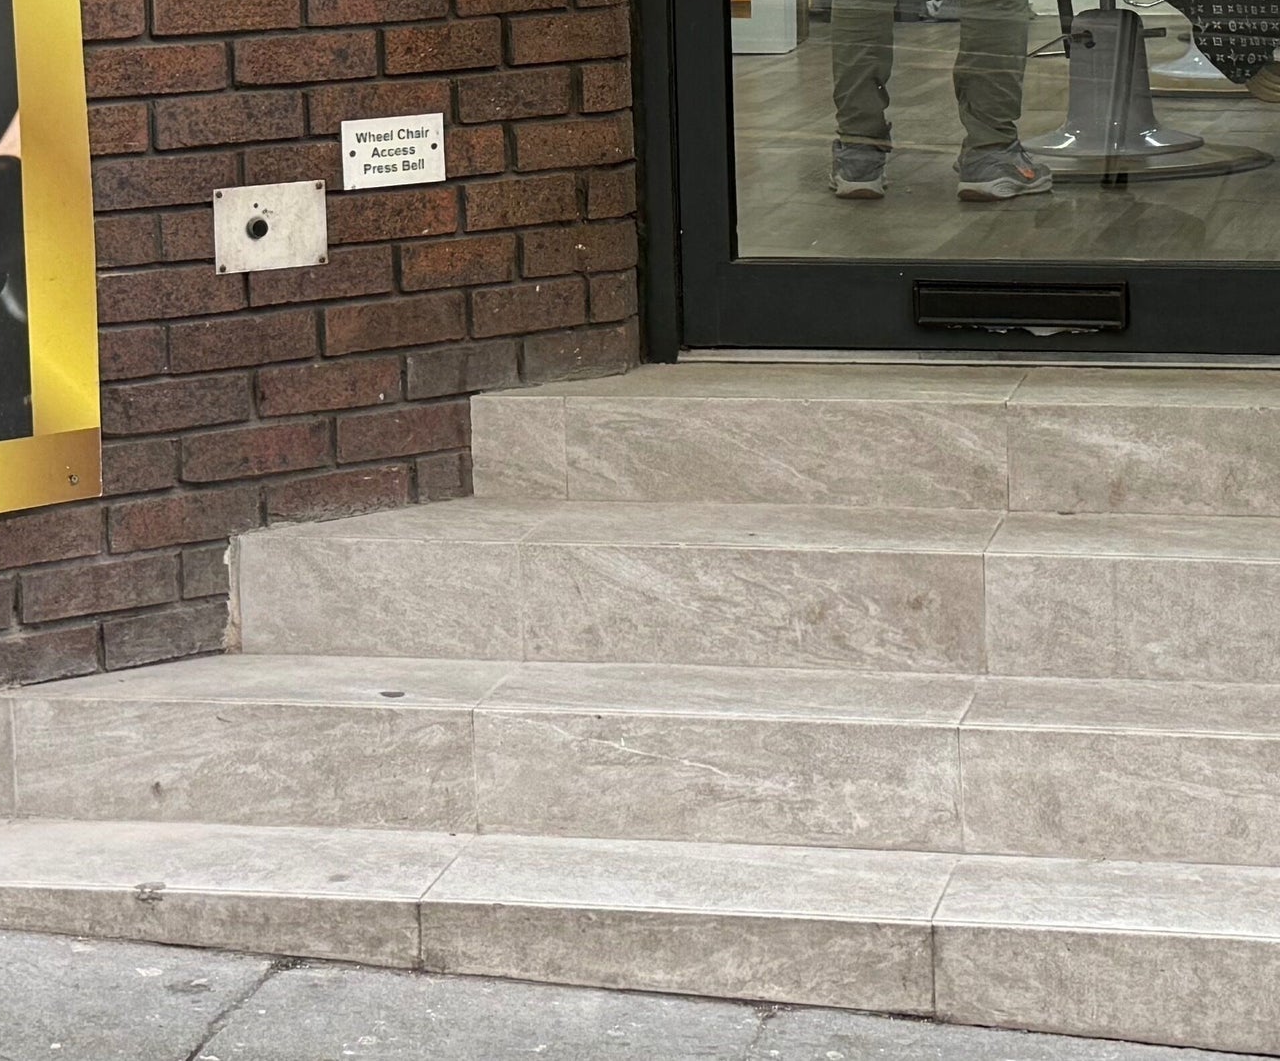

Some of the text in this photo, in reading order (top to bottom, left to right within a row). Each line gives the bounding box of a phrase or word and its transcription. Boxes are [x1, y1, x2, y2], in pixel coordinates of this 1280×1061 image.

[355, 127, 430, 144] Wheel Chair
[370, 145, 416, 159] Access
[363, 158, 425, 175] Press Bell
